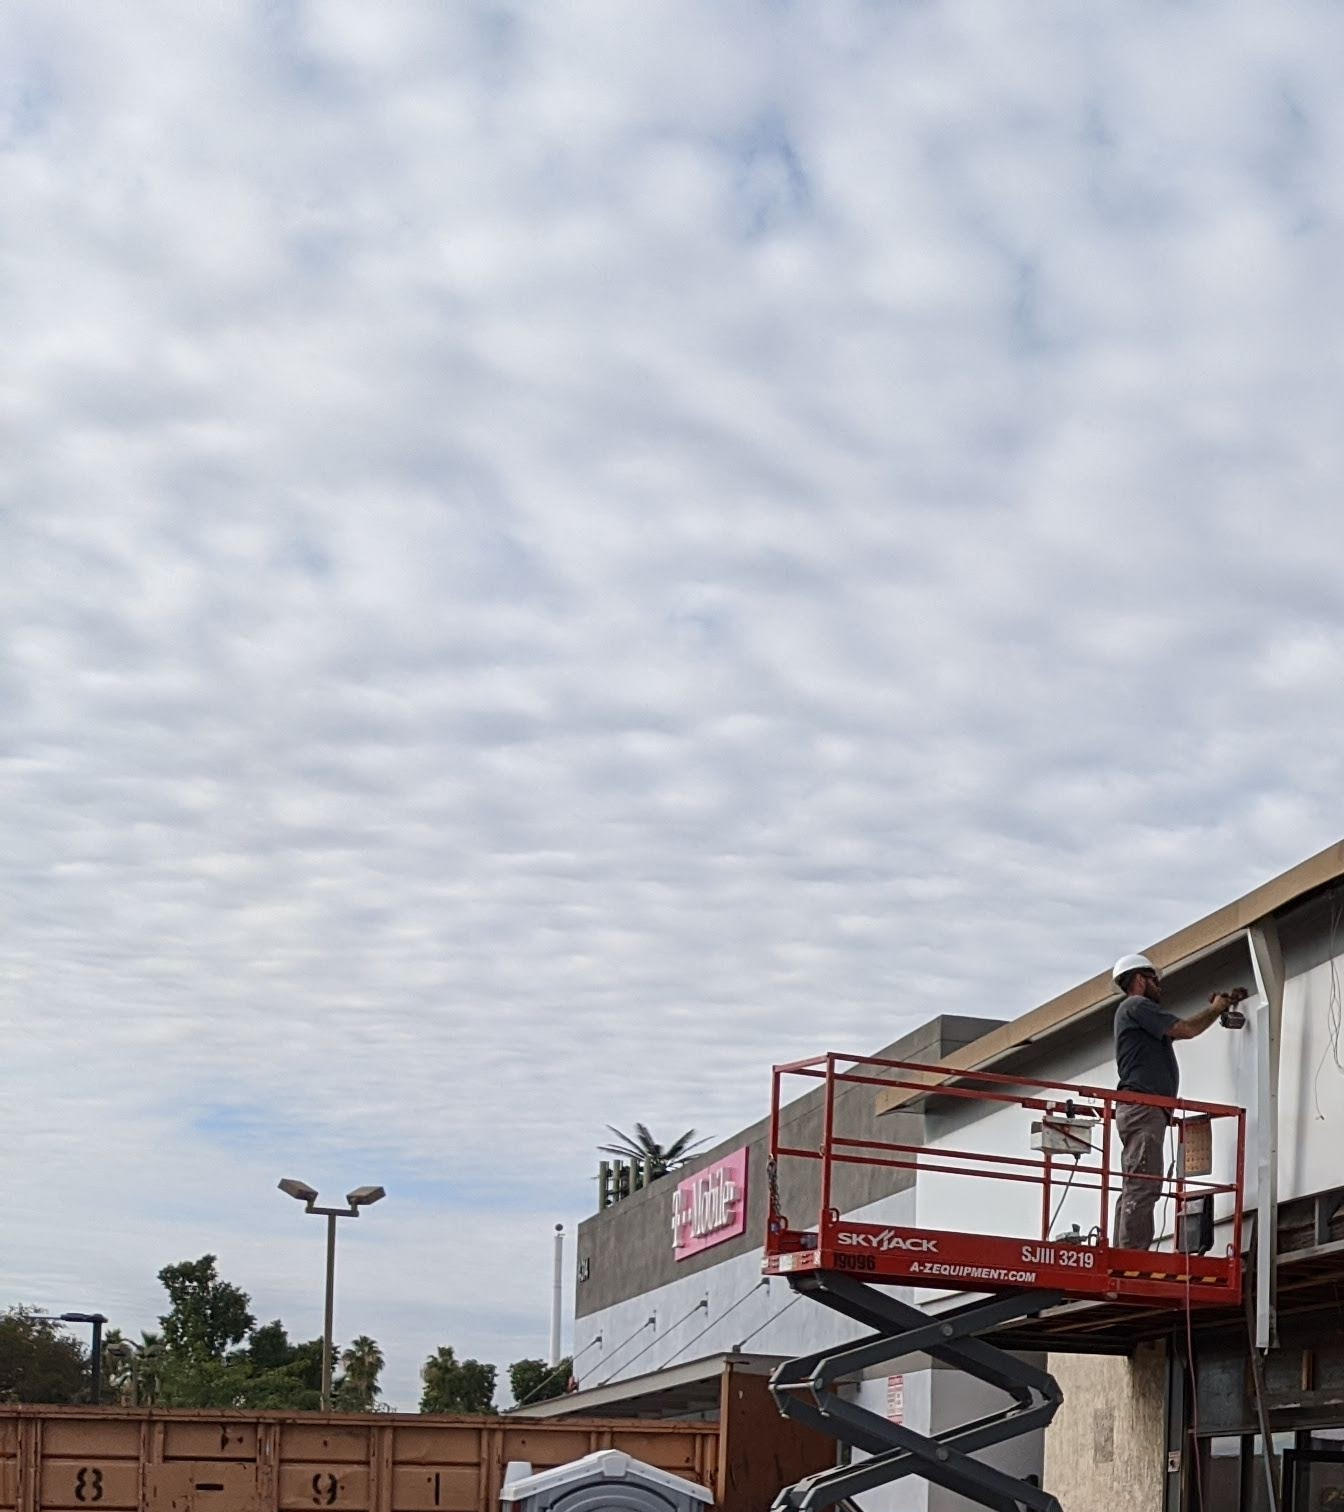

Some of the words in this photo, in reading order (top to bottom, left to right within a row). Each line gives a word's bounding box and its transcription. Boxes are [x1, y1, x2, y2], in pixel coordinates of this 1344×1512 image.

[837, 1229, 940, 1252] SKYJACK
[1021, 1245, 1055, 1265] SJIII
[1058, 1250, 1095, 1269] 3219
[909, 1261, 1037, 1283] A-ZEQUIPMENT.COM
